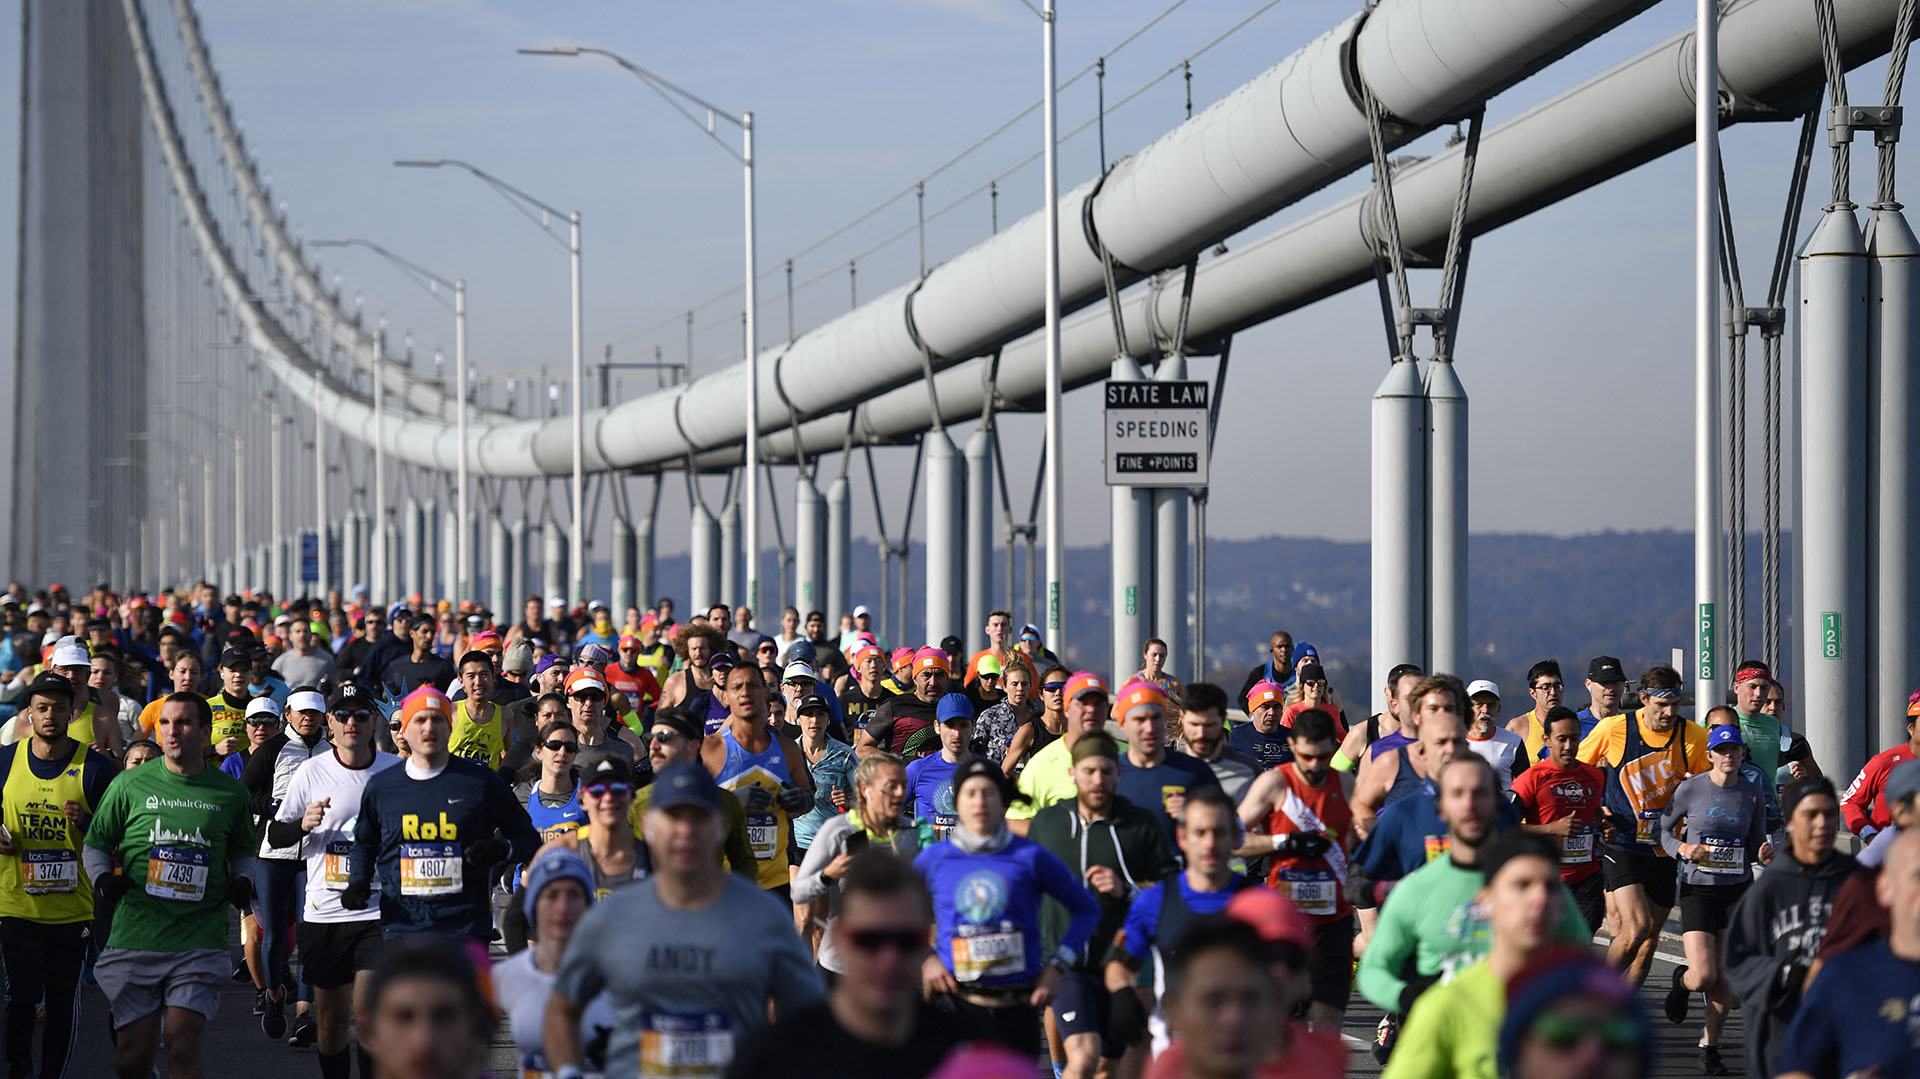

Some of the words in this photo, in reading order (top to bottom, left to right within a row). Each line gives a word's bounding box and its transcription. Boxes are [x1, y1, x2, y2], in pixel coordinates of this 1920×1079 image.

[1108, 386, 1159, 403] STATE
[1170, 386, 1206, 403] LAW
[1116, 421, 1198, 438] SPEEDING
[1119, 457, 1143, 470] FINE
[1701, 605, 1711, 679] LP128
[1826, 615, 1837, 657] 128
[1627, 759, 1675, 796] NYC
[20, 813, 67, 829] TEAM
[402, 811, 458, 841] Rob
[935, 815, 949, 825] tcs
[29, 826, 67, 842] KIDS
[28, 852, 42, 862] tcs
[159, 848, 174, 860] tcs
[408, 847, 423, 858] tcs
[40, 863, 63, 880] 3747
[167, 863, 194, 884] 7439
[420, 859, 447, 878] 4807
[645, 945, 718, 976] ANDY
